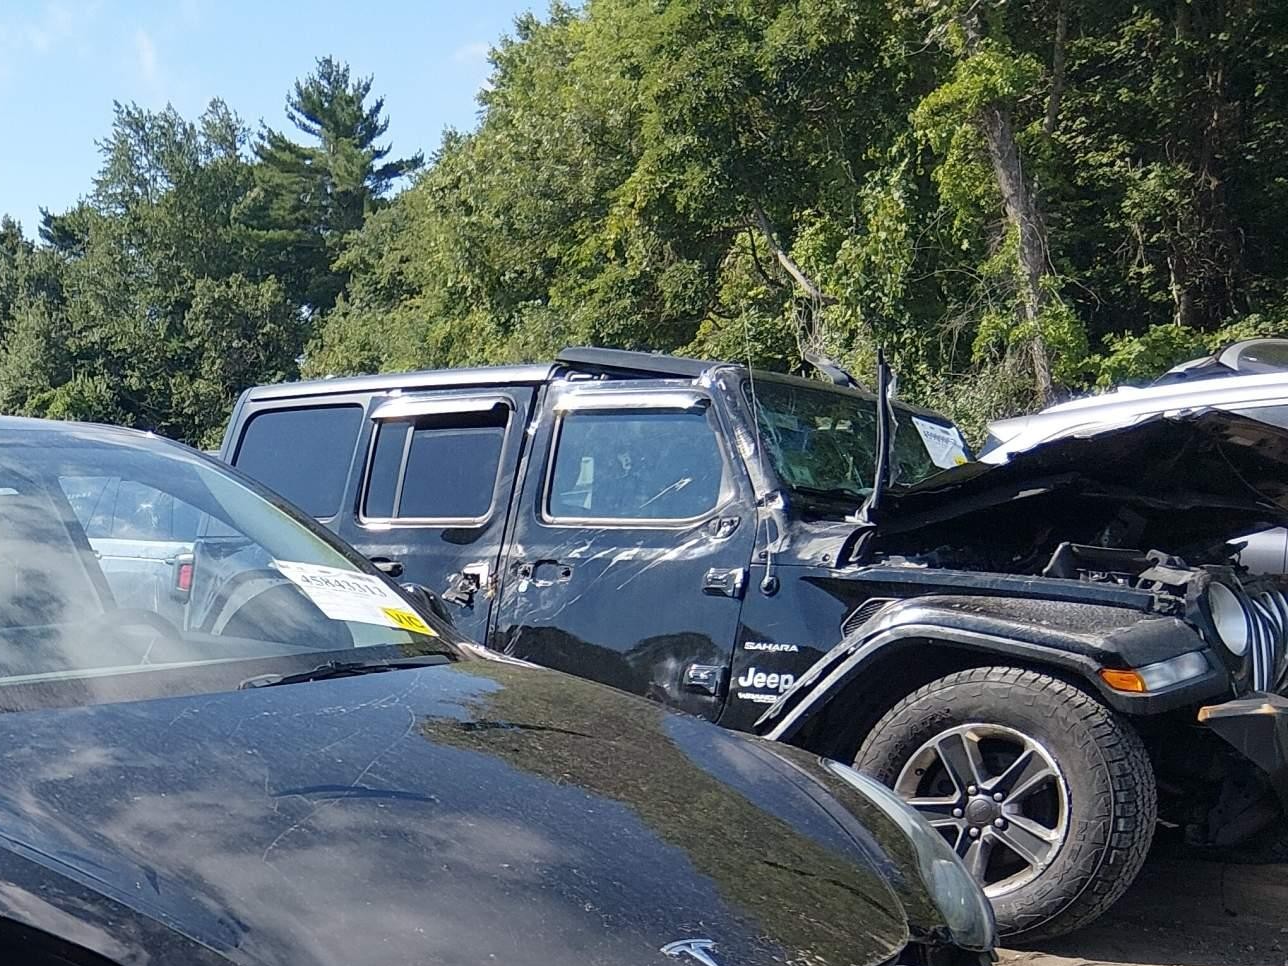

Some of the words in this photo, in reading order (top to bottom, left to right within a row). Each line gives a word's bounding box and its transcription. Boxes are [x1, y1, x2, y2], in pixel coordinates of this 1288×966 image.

[385, 608, 426, 629] VIC
[744, 641, 799, 653] SAHARA
[738, 667, 794, 693] Jeep
